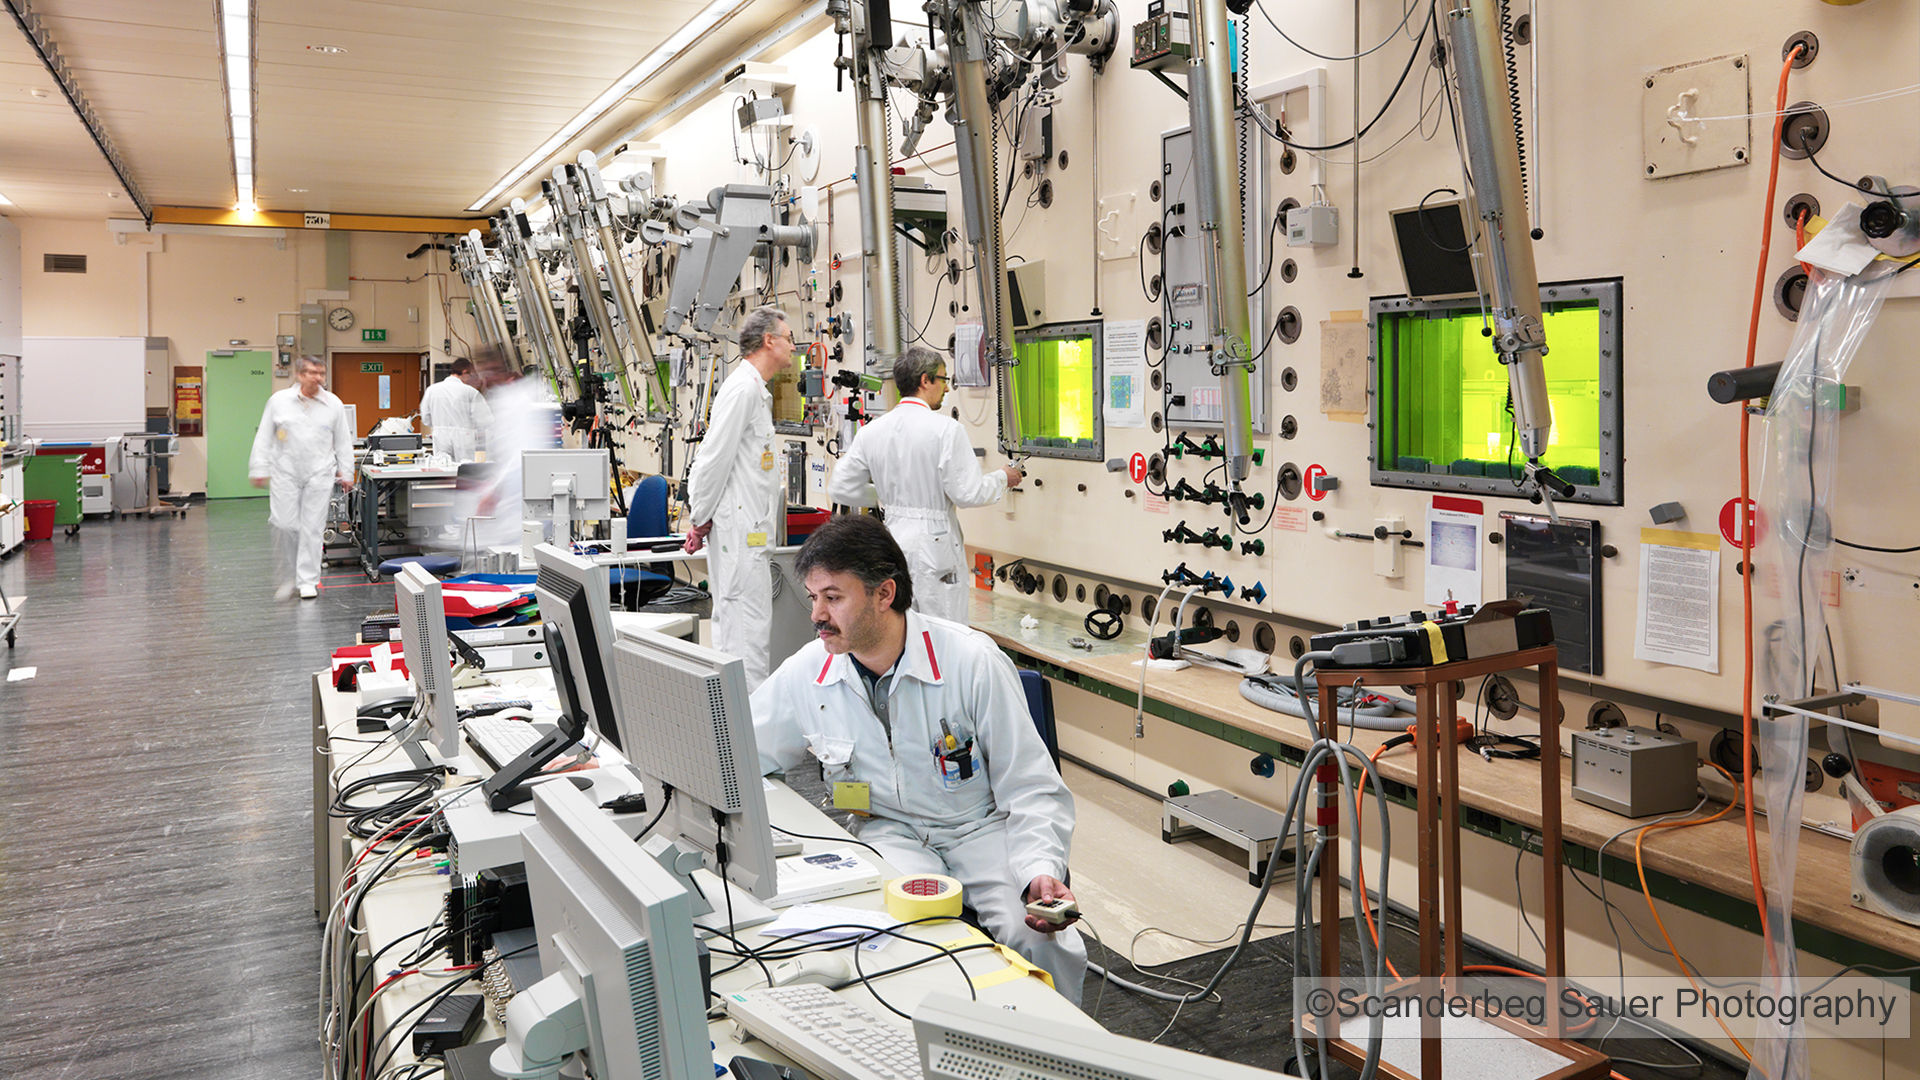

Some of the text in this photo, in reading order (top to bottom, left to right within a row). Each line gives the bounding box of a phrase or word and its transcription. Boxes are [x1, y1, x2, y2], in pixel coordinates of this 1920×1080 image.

[305, 215, 324, 225] 750
[361, 363, 383, 372] EXIT
[1134, 455, 1143, 479] F
[818, 477, 823, 488] 2
